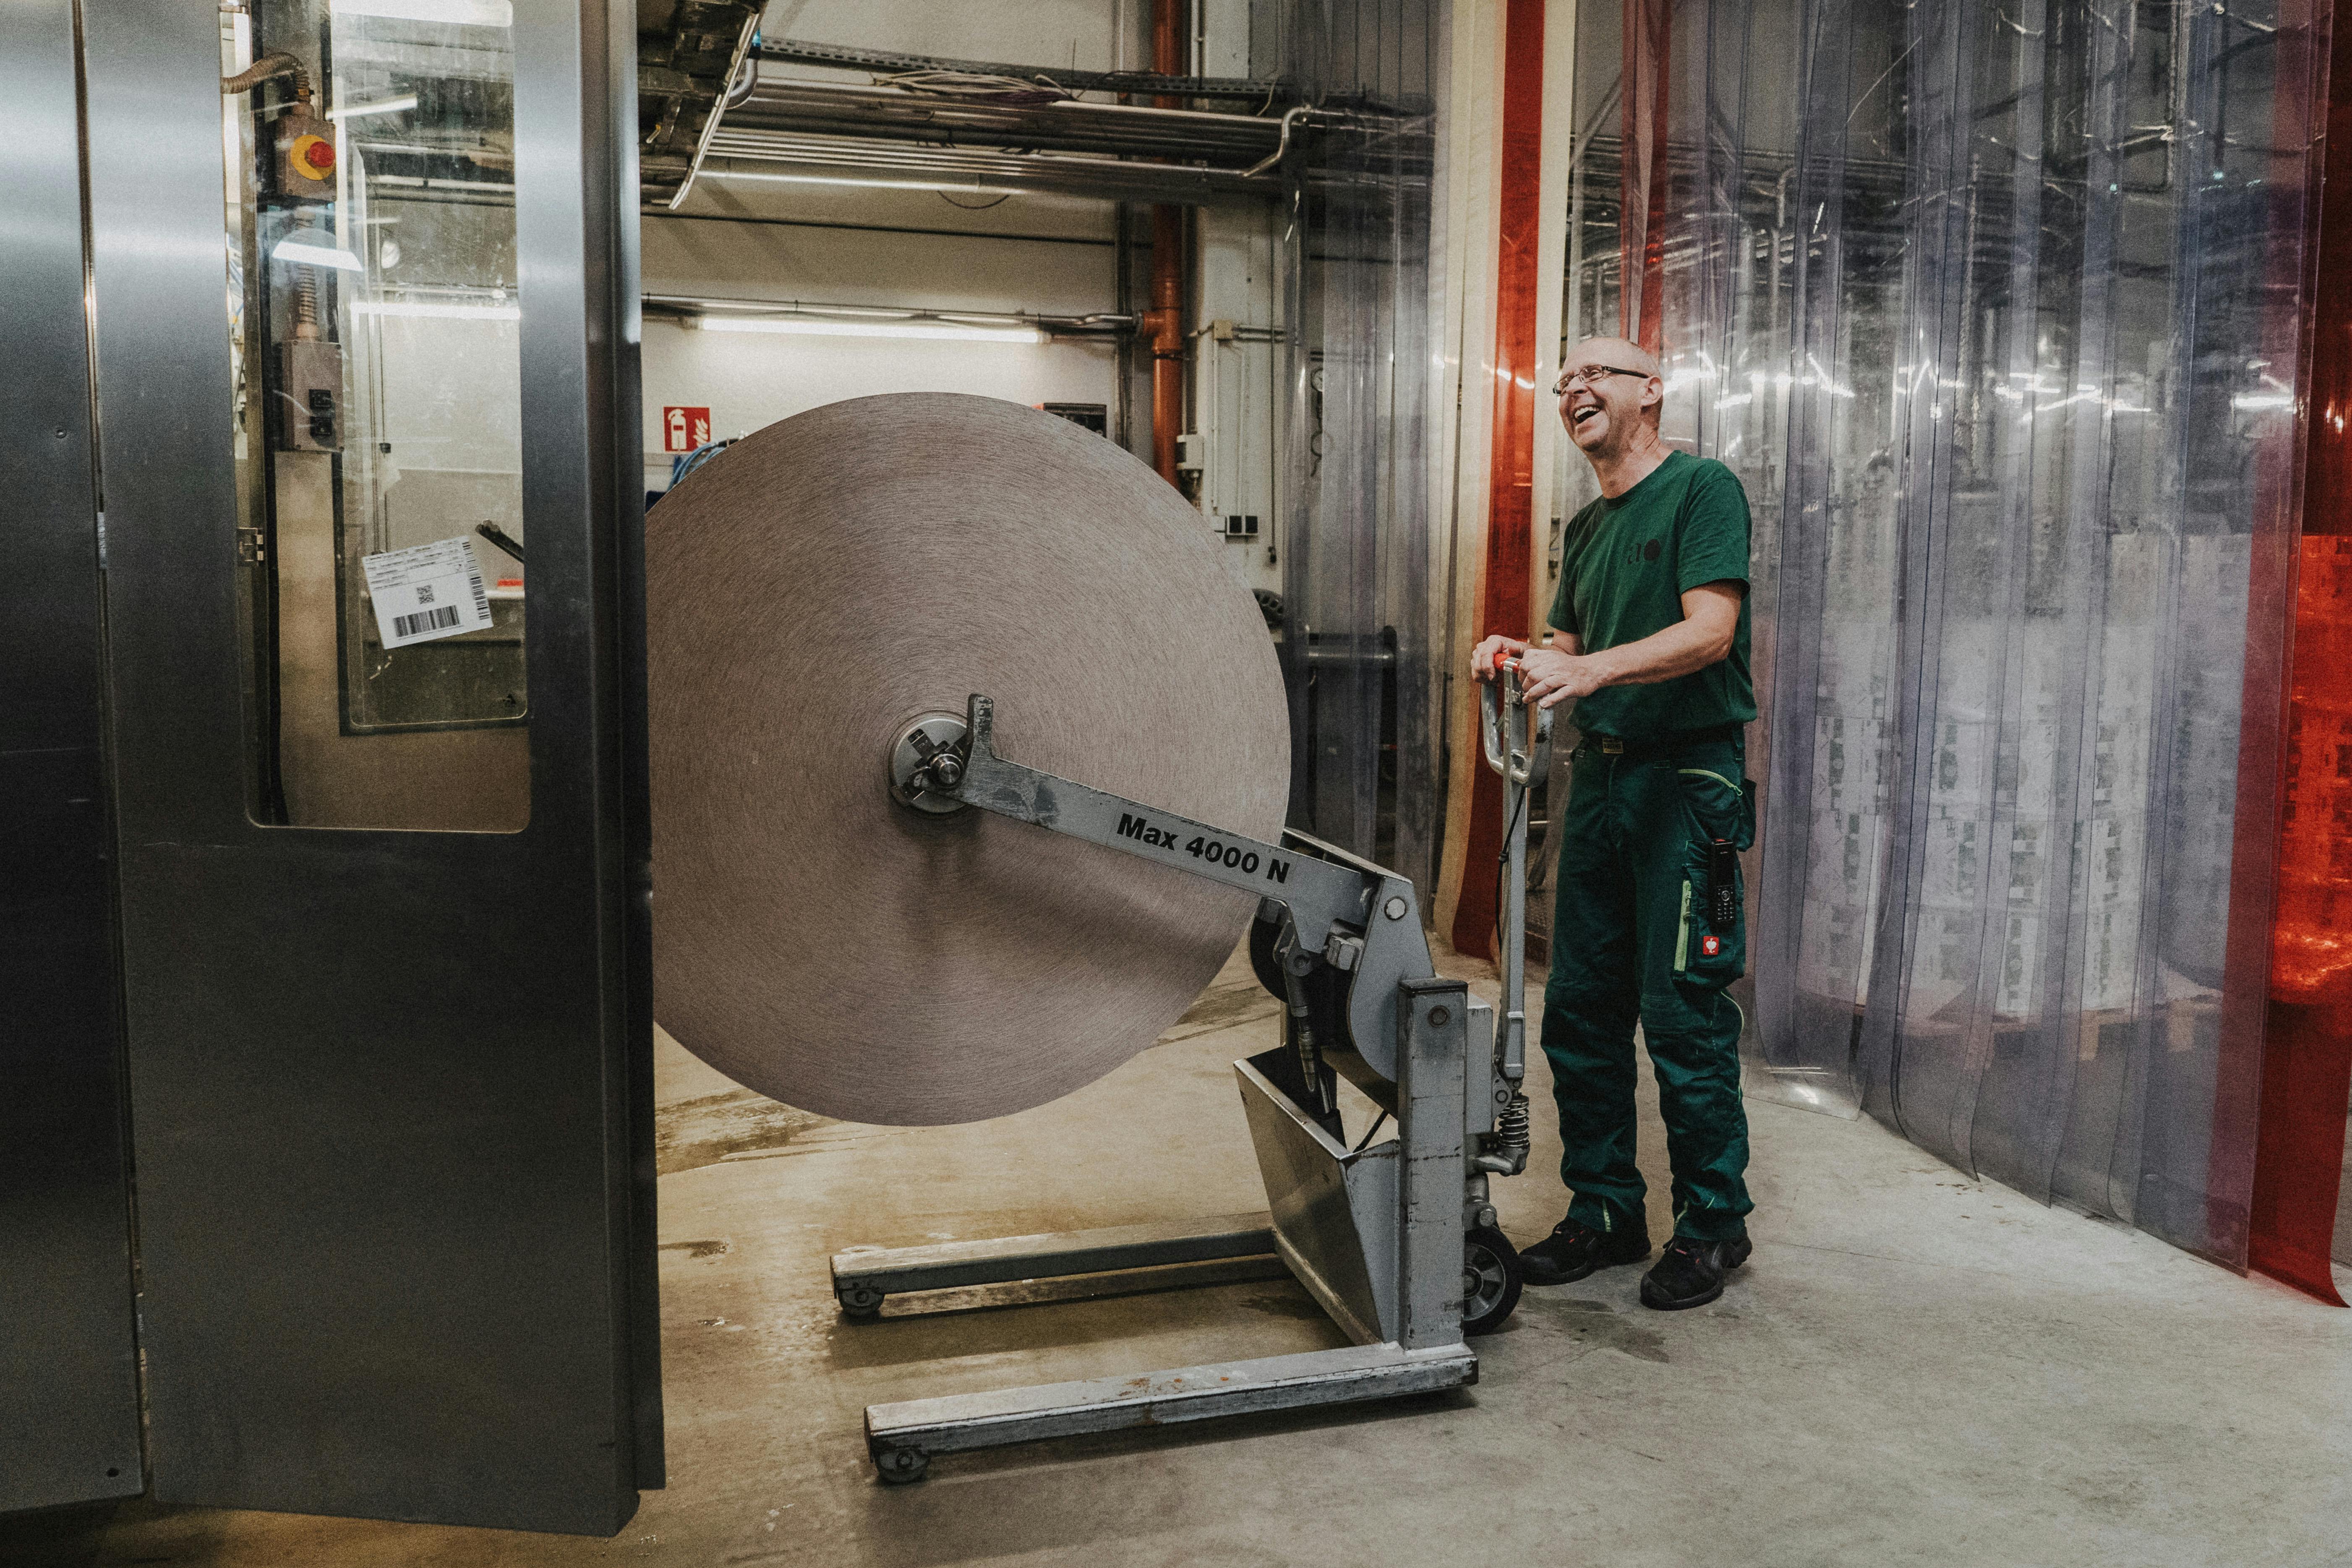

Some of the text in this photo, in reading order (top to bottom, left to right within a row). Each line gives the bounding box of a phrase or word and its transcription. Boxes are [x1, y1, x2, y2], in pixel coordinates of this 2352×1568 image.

[1117, 813, 1290, 884] Max 4000 N
